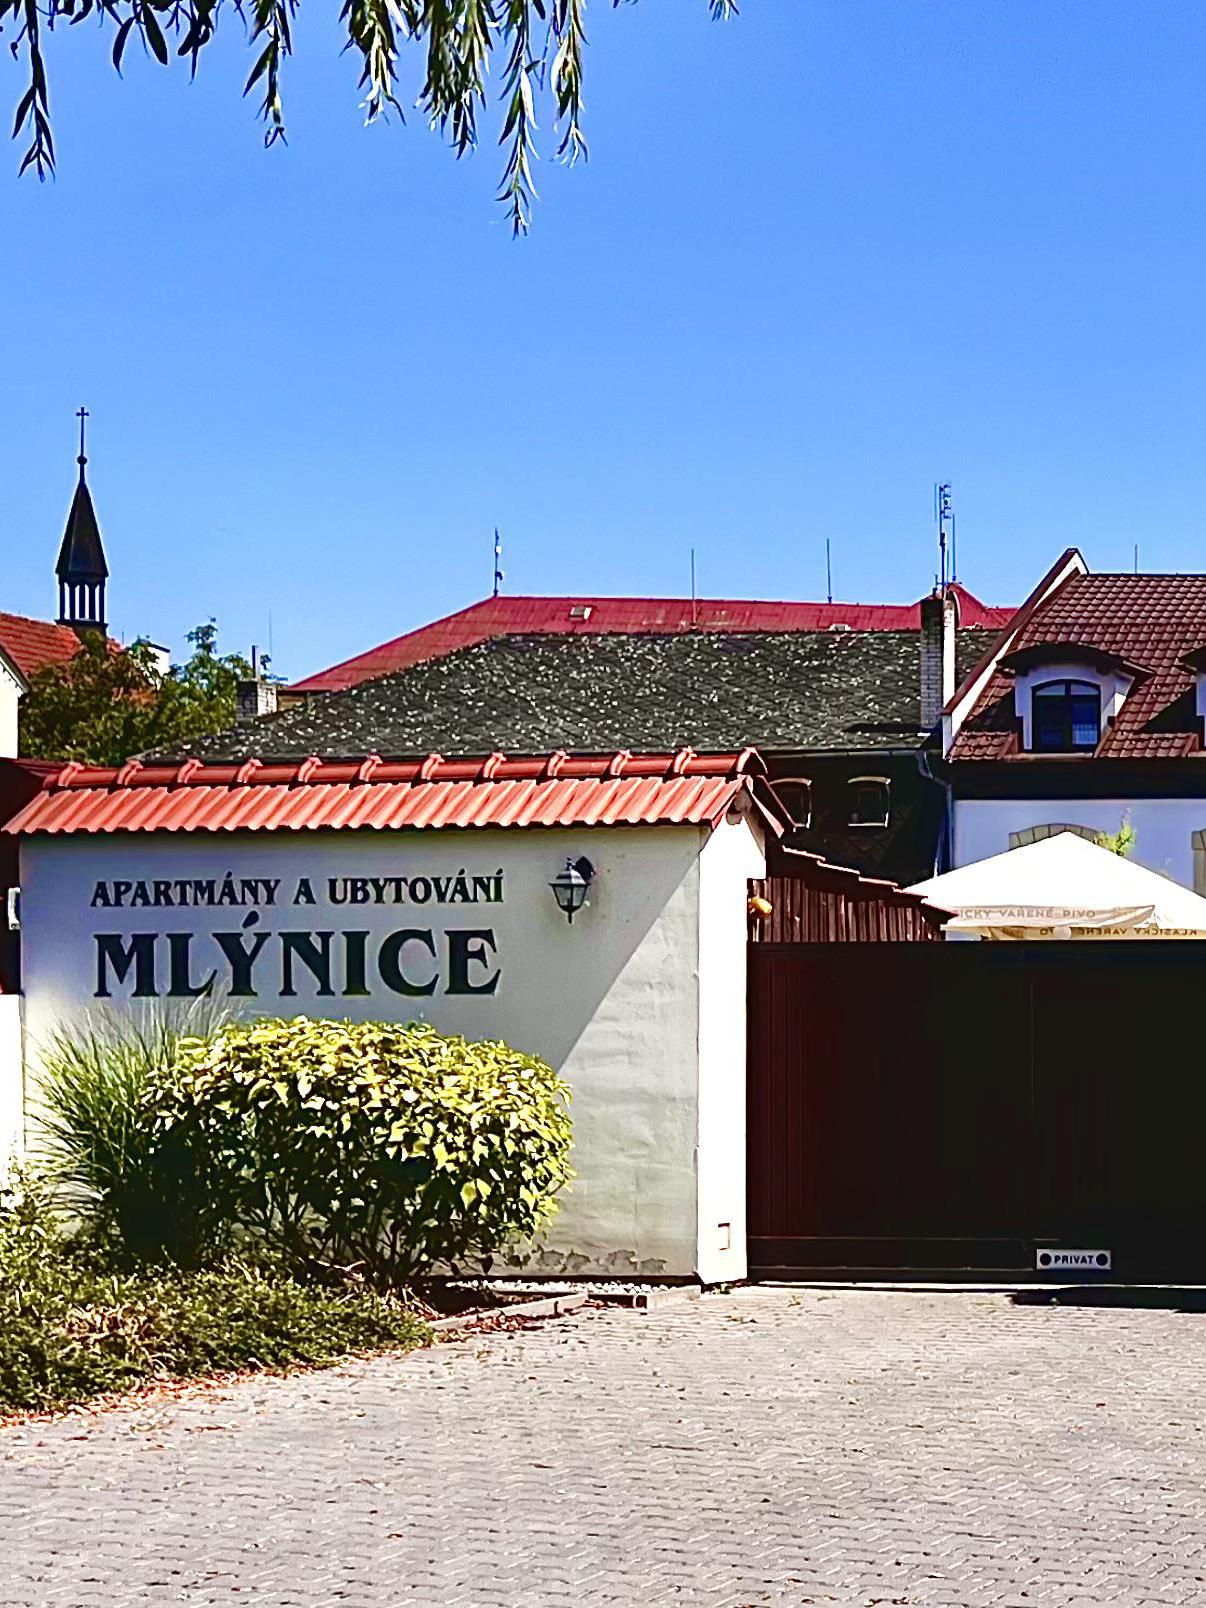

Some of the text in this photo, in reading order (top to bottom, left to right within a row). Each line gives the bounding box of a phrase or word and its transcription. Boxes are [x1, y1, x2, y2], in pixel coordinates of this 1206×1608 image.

[90, 869, 504, 907] APARTMÁNY A UBYTOVÁNÍ
[1062, 909, 1096, 918] PIVO
[93, 910, 501, 997] MLÝNICE
[1054, 1255, 1094, 1265] PRIVAT
